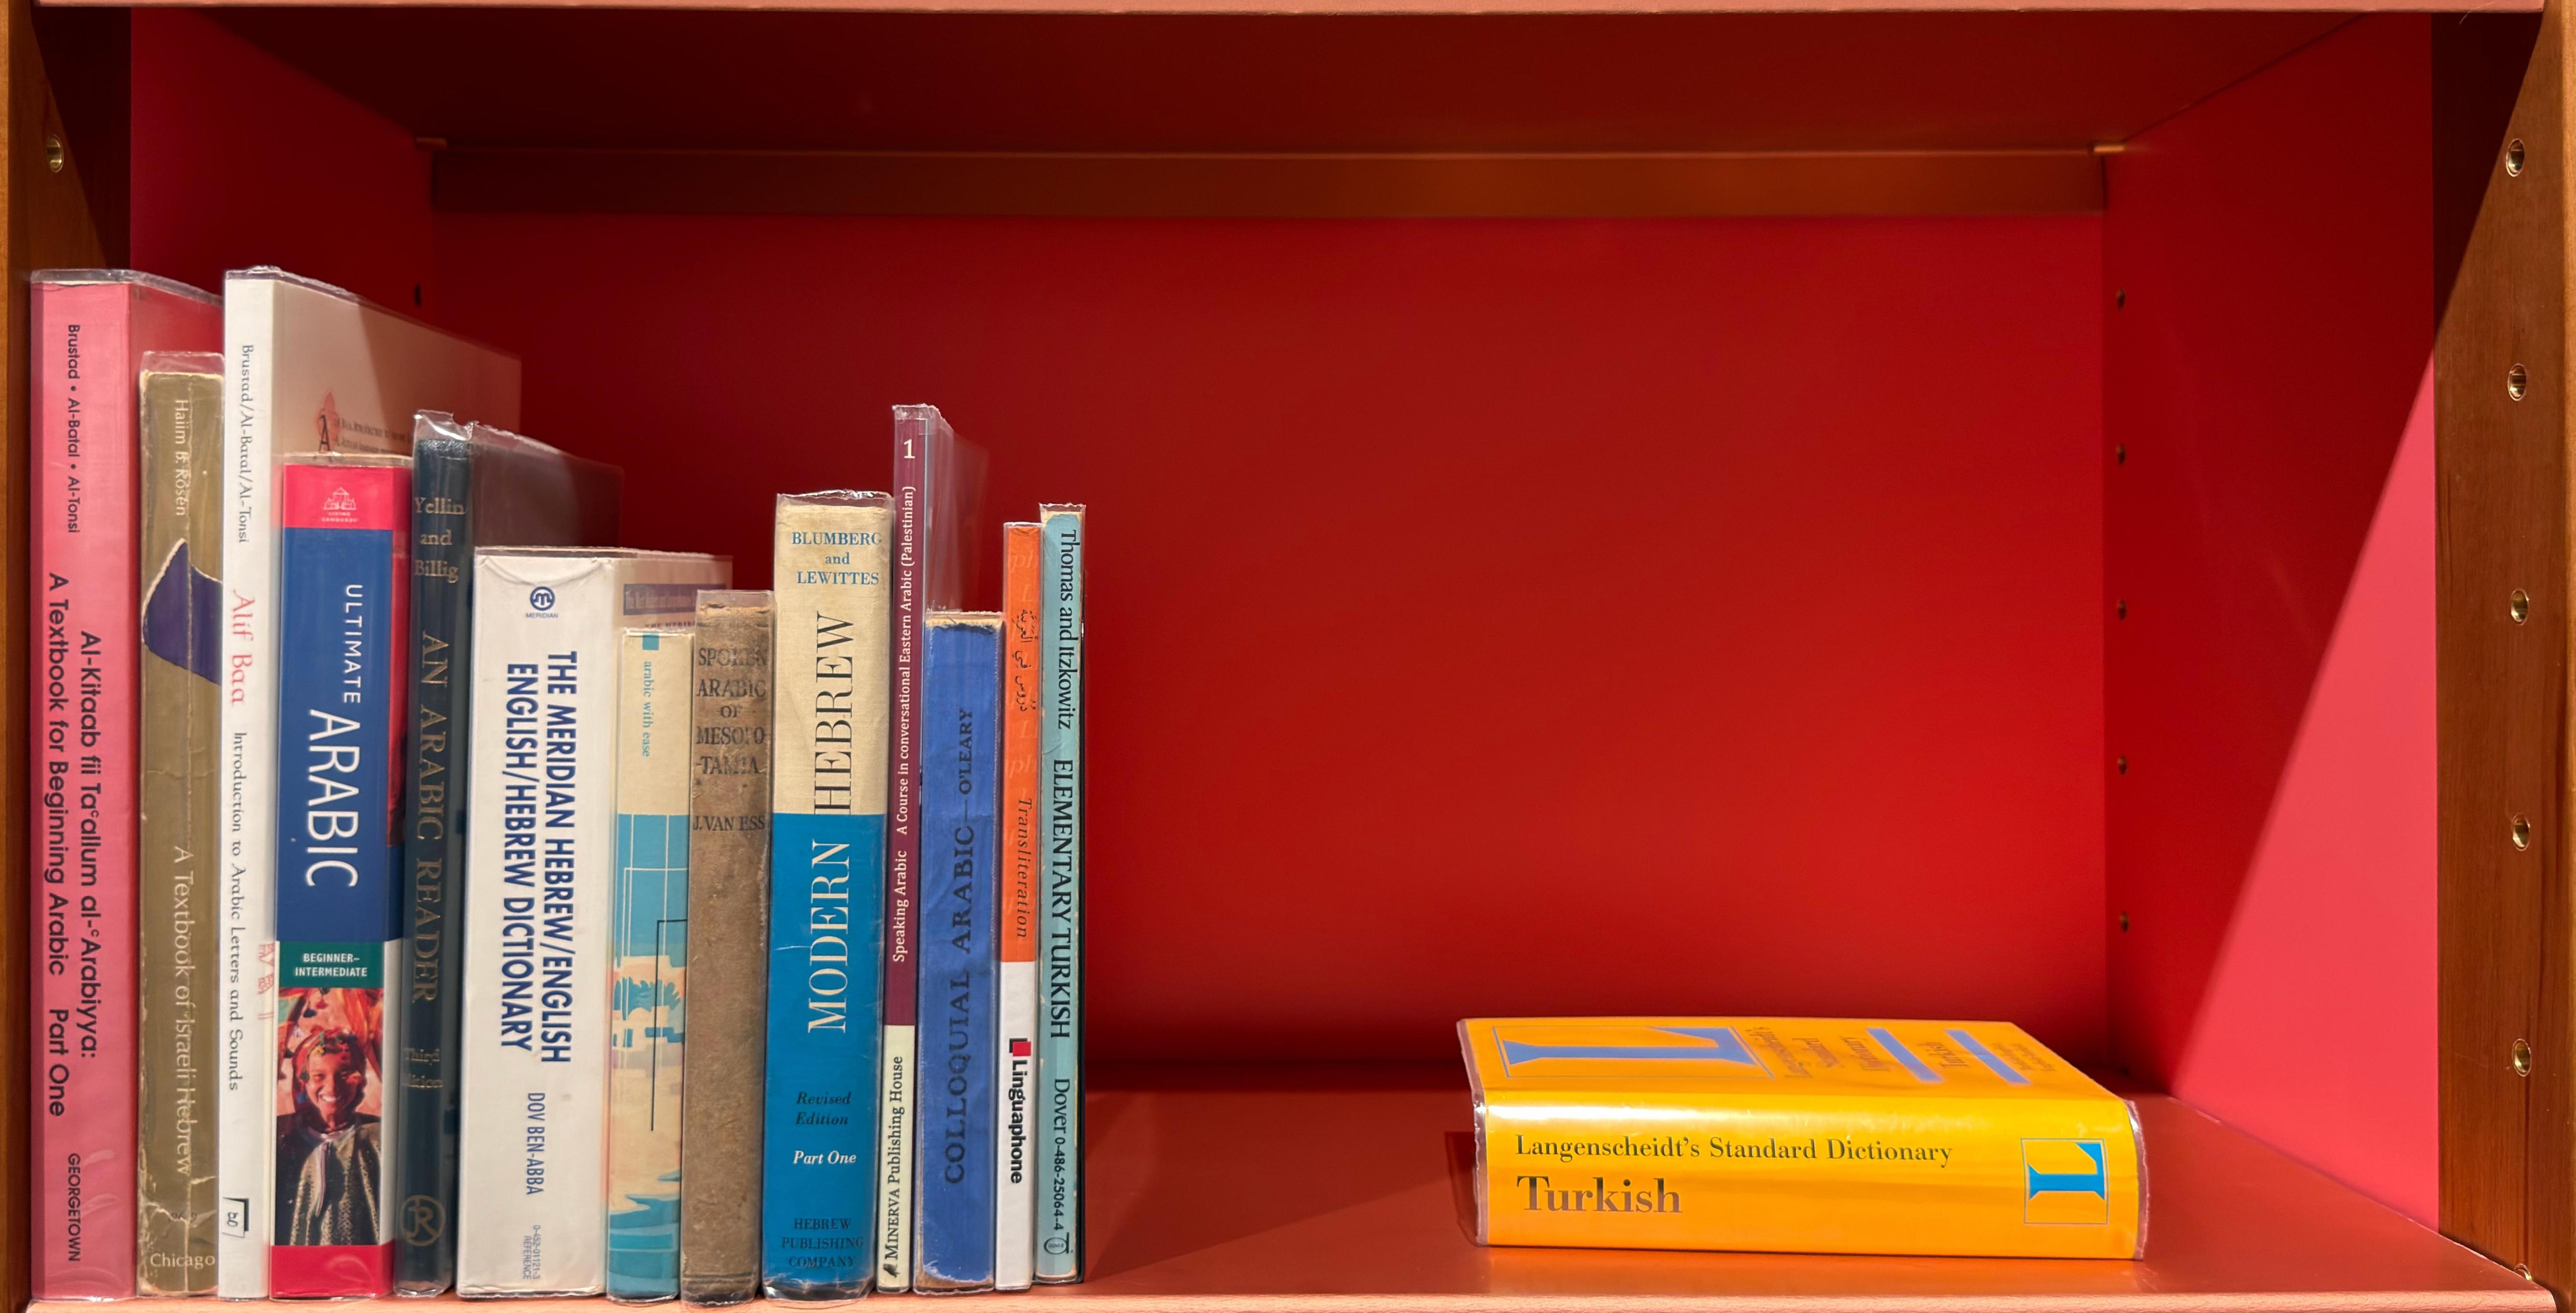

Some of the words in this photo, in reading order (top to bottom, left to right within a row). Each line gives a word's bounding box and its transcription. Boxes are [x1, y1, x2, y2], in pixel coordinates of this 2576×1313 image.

[67, 324, 80, 379] Brustad
[68, 398, 80, 458] Al-Batal
[903, 439, 916, 459] 1
[68, 476, 80, 533] Al-Tonsi
[415, 497, 466, 515] Yellin
[901, 486, 916, 567] (Palestinian)
[420, 530, 452, 545] and
[792, 532, 882, 545] BLUMBERG
[825, 552, 850, 565] and
[49, 573, 69, 591] A
[416, 560, 459, 583] Billig
[797, 571, 879, 586] LEWITTES
[900, 570, 912, 612] Arabic
[1060, 529, 1081, 601] Thomas
[232, 589, 255, 642] Alif
[900, 614, 912, 663] Eastern
[1059, 608, 1079, 641] and
[49, 600, 69, 712] Textbook
[344, 584, 363, 704] ULTIMATE
[421, 631, 450, 688] AN
[80, 631, 102, 748] Al-Kitaab
[232, 653, 253, 706] Baa
[547, 651, 578, 695] THE
[644, 660, 652, 697] arabic
[697, 678, 766, 697] ARABIC
[1058, 646, 1078, 729] Itzkowitz
[49, 720, 69, 753] for
[643, 703, 652, 729] with
[814, 610, 854, 815] HEBREW
[898, 666, 911, 759] conversational
[81, 754, 102, 775] fii
[545, 704, 577, 828] MERIDIAN
[642, 732, 650, 758] ease
[898, 762, 909, 776] in
[232, 732, 247, 833] Introduction
[305, 708, 361, 887] ARABIC
[416, 704, 447, 841] ARABIC
[502, 664, 540, 887] ENGLISH/HEBREW
[44, 761, 69, 884] Beginning
[705, 815, 735, 831] VAN
[739, 815, 765, 831] ESS
[896, 778, 909, 823] Course
[173, 846, 194, 863] A
[231, 840, 242, 857] to
[896, 826, 907, 835] A
[1052, 760, 1074, 923] ELEMENTARY
[231, 862, 247, 920] Arabic
[894, 850, 907, 896] Arabic
[951, 825, 976, 954] ARABIC
[1016, 798, 1033, 938] Transliteration
[49, 892, 69, 975] Arabic
[174, 871, 195, 978] Textbook
[412, 859, 443, 1003] READER
[540, 839, 576, 1062] HEBREW/ENGLISH
[807, 838, 850, 1034] MODERN
[893, 899, 909, 962] Speaking
[230, 925, 246, 984] Letters
[295, 966, 368, 977] INTERMEDIATE
[500, 898, 535, 1051] DICTIONARY
[175, 986, 196, 1007] of
[229, 990, 242, 1021] and
[1050, 929, 1071, 1038] TURKISH
[49, 1009, 70, 1054] Part
[175, 1019, 197, 1078] Israeli
[228, 1030, 244, 1091] Sounds
[890, 1056, 903, 1102] House
[945, 970, 973, 1184] COLLOQUIAL
[49, 1063, 70, 1117] One
[527, 1092, 546, 1121] DOV
[797, 1091, 852, 1105] Revised
[1054, 1078, 1070, 1133] Dover
[175, 1088, 197, 1176] Hebrew
[795, 1111, 849, 1126] Edition
[1008, 1059, 1027, 1184] Linguaphone
[526, 1126, 546, 1196] BEN-ABBA
[793, 1150, 824, 1165] Part
[827, 1150, 857, 1165] One
[887, 1106, 905, 1185] Publishing
[1515, 1134, 1700, 1163] Langenscheidt's
[1710, 1136, 1817, 1160] Standard
[1826, 1138, 1953, 1168] Dictionary
[67, 1153, 81, 1262] GEORGETOWN
[1053, 1136, 1066, 1231] 0-486-25064-4
[1516, 1175, 1683, 1214] Turkish
[782, 1237, 864, 1249] PUBLISHING
[794, 1218, 852, 1230] HEBREW
[884, 1187, 900, 1260] MINERVA
[150, 1252, 216, 1270] Chicago
[523, 1235, 532, 1280] REFERENCE
[788, 1255, 856, 1268] COMPANY
